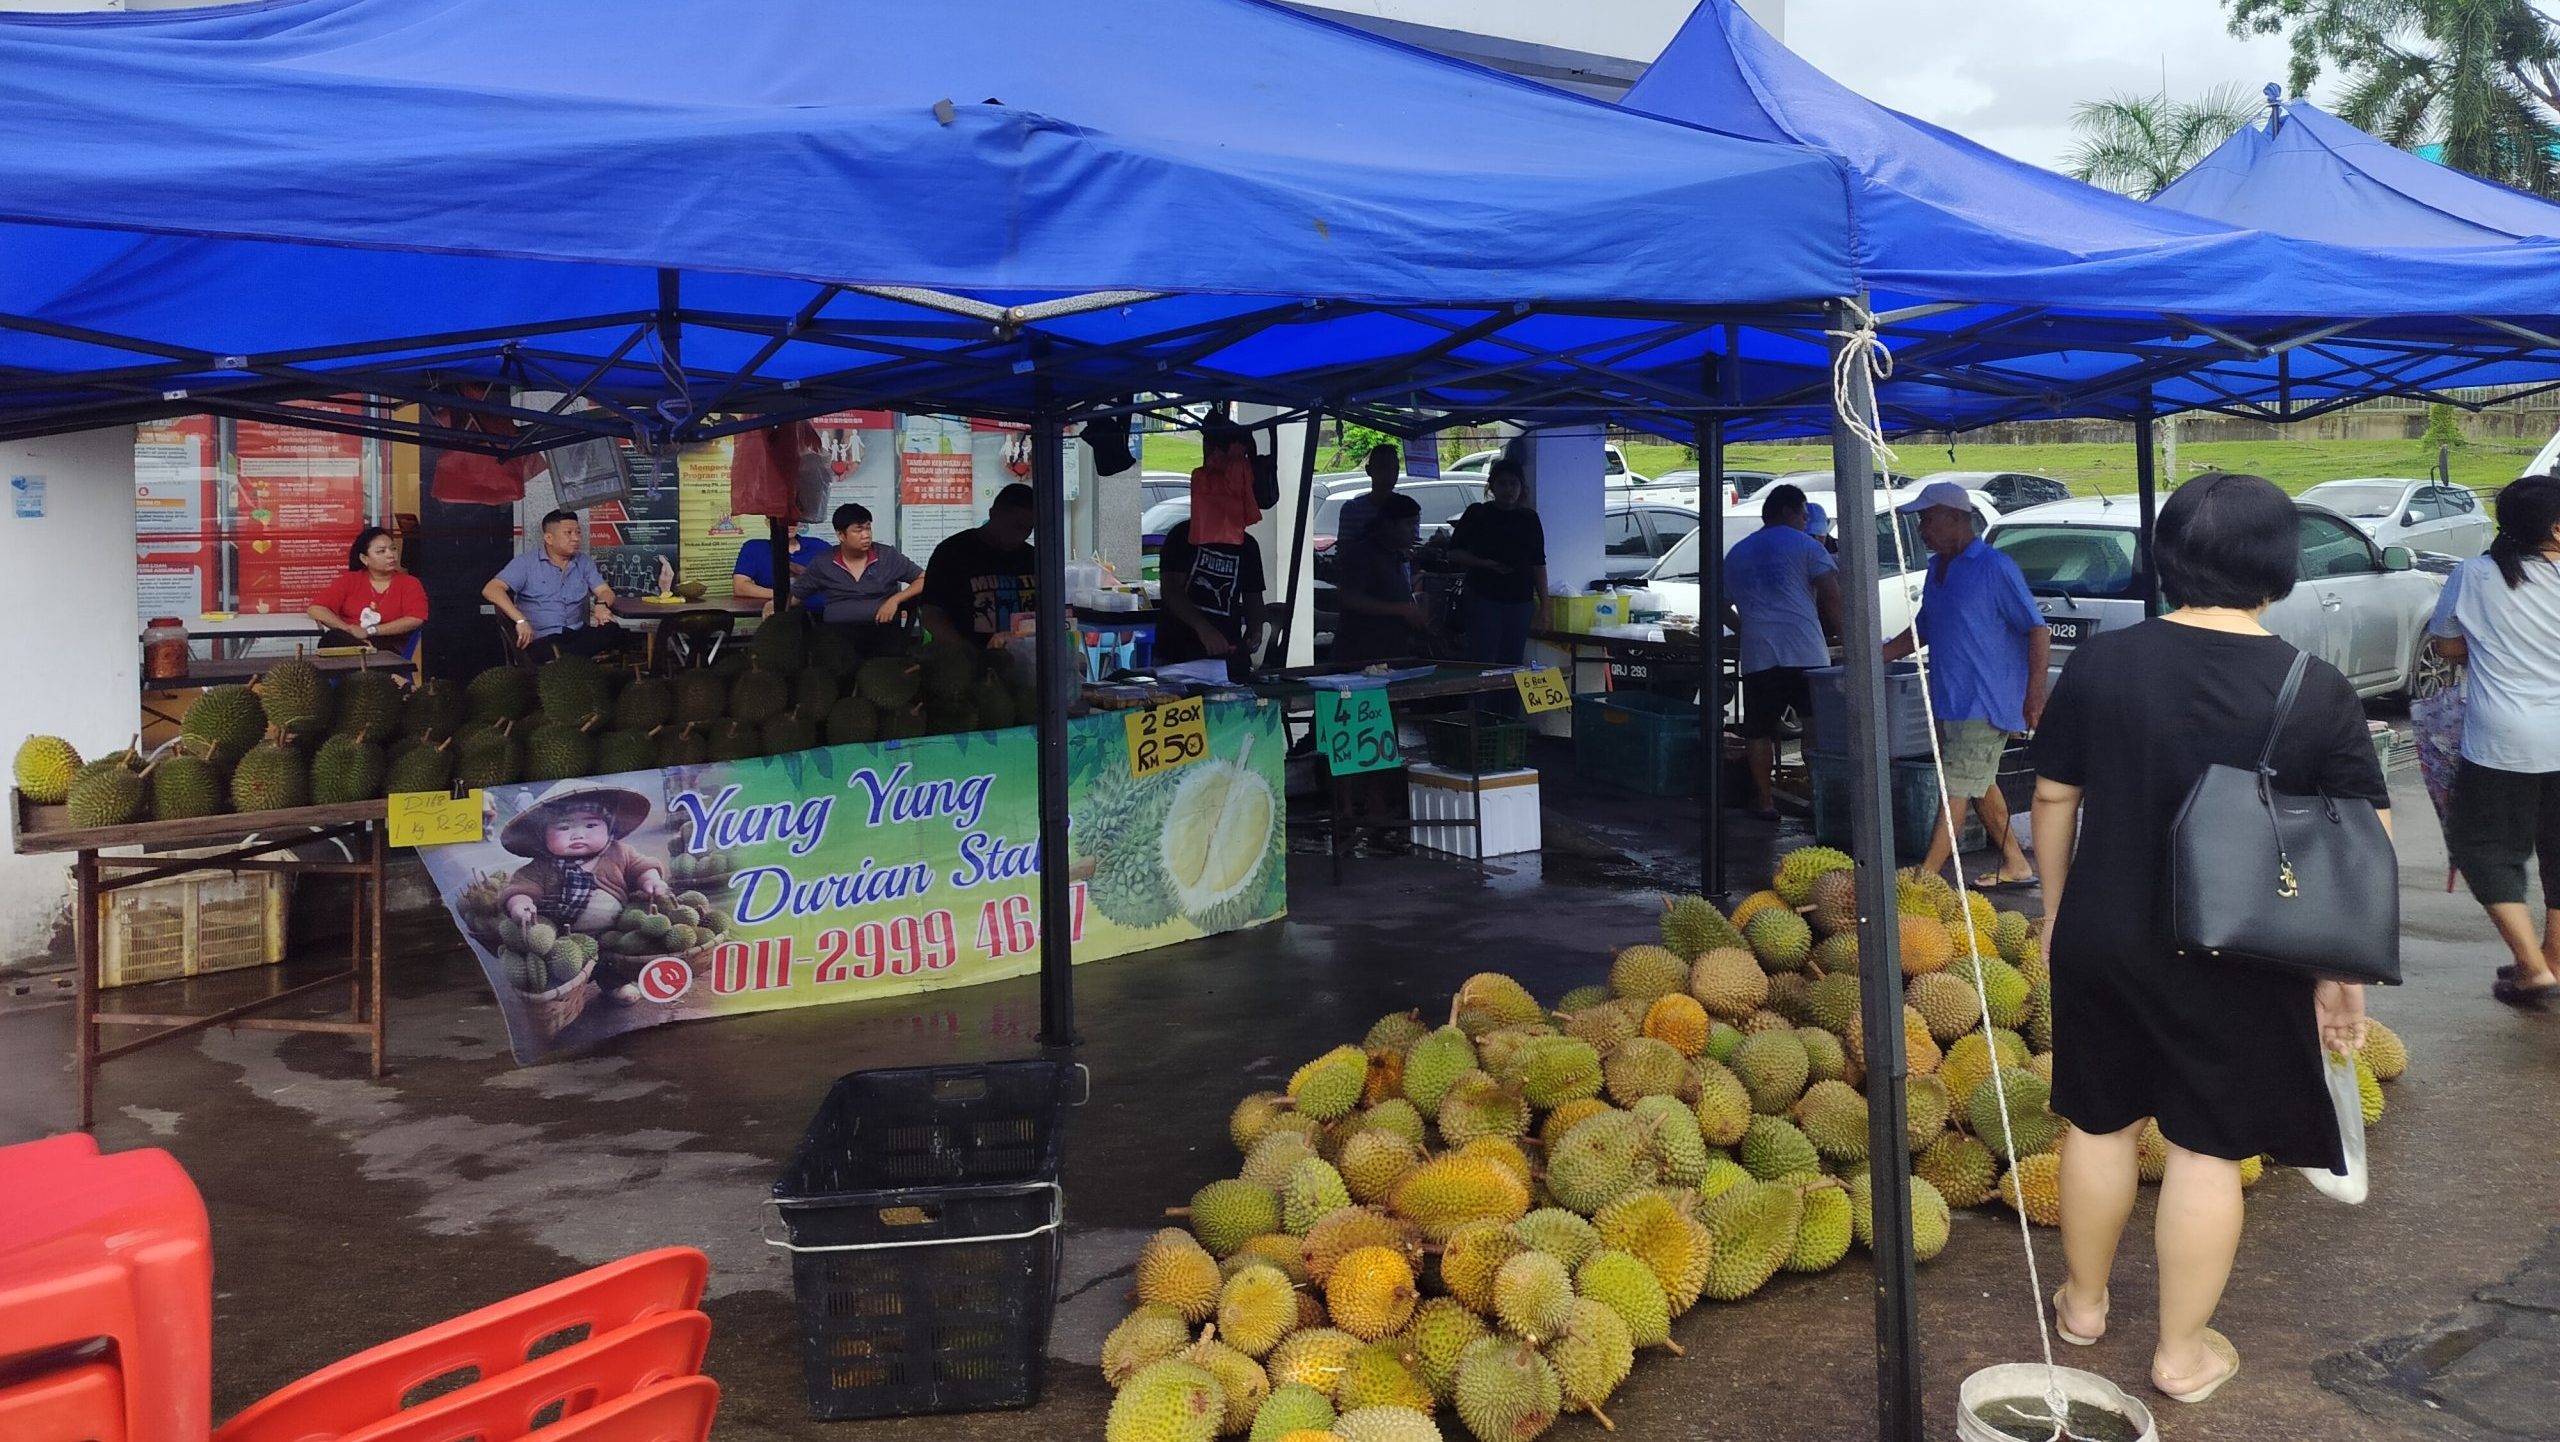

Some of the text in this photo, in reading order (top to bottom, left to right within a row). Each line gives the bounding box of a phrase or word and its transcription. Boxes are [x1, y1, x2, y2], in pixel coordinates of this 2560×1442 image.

[2047, 623, 2077, 638] 5028
[1523, 677, 1531, 688] 6
[1545, 688, 1563, 705] 50
[1141, 713, 1157, 735] 2
[1334, 698, 1352, 727] 4
[1138, 732, 1204, 772] RM 50
[1332, 731, 1352, 763] RM
[1357, 726, 1398, 767] 50
[670, 762, 996, 856] Yung Yung
[728, 831, 1044, 925] Durian Stal
[713, 883, 1087, 994] 011-2999 467
